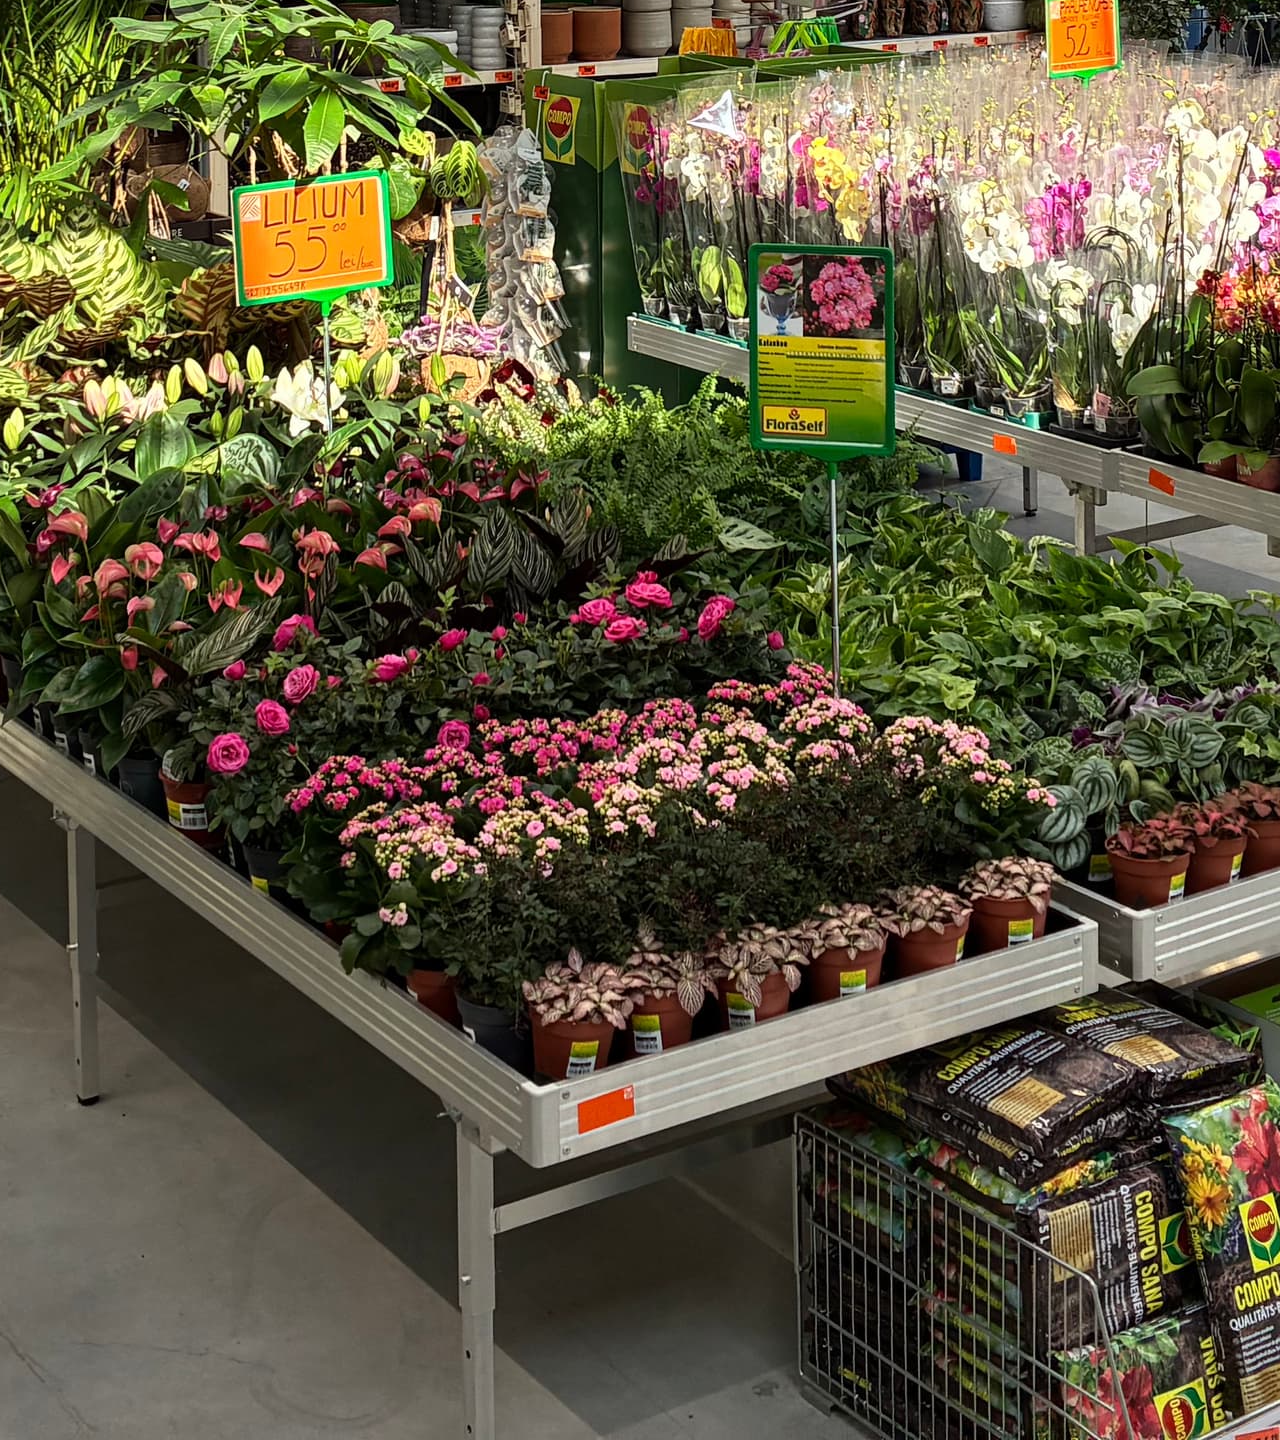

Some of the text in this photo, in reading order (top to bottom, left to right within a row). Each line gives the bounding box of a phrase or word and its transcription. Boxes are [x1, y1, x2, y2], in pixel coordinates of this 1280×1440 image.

[1064, 24, 1090, 58] 52
[548, 109, 572, 126] COMPO
[264, 182, 364, 228] LILIUM
[269, 226, 327, 278] 55
[766, 419, 823, 432] FloraSelf
[936, 1046, 990, 1082] COMPO
[1249, 1211, 1275, 1232] COMPO
[1119, 1184, 1144, 1325] QUALITÄTS-BLUMENERD
[1135, 1189, 1164, 1315] COMPO SANA
[1190, 1227, 1203, 1260] COMPO
[1233, 1273, 1280, 1311] COMPO
[1198, 1336, 1220, 1389] SANA
